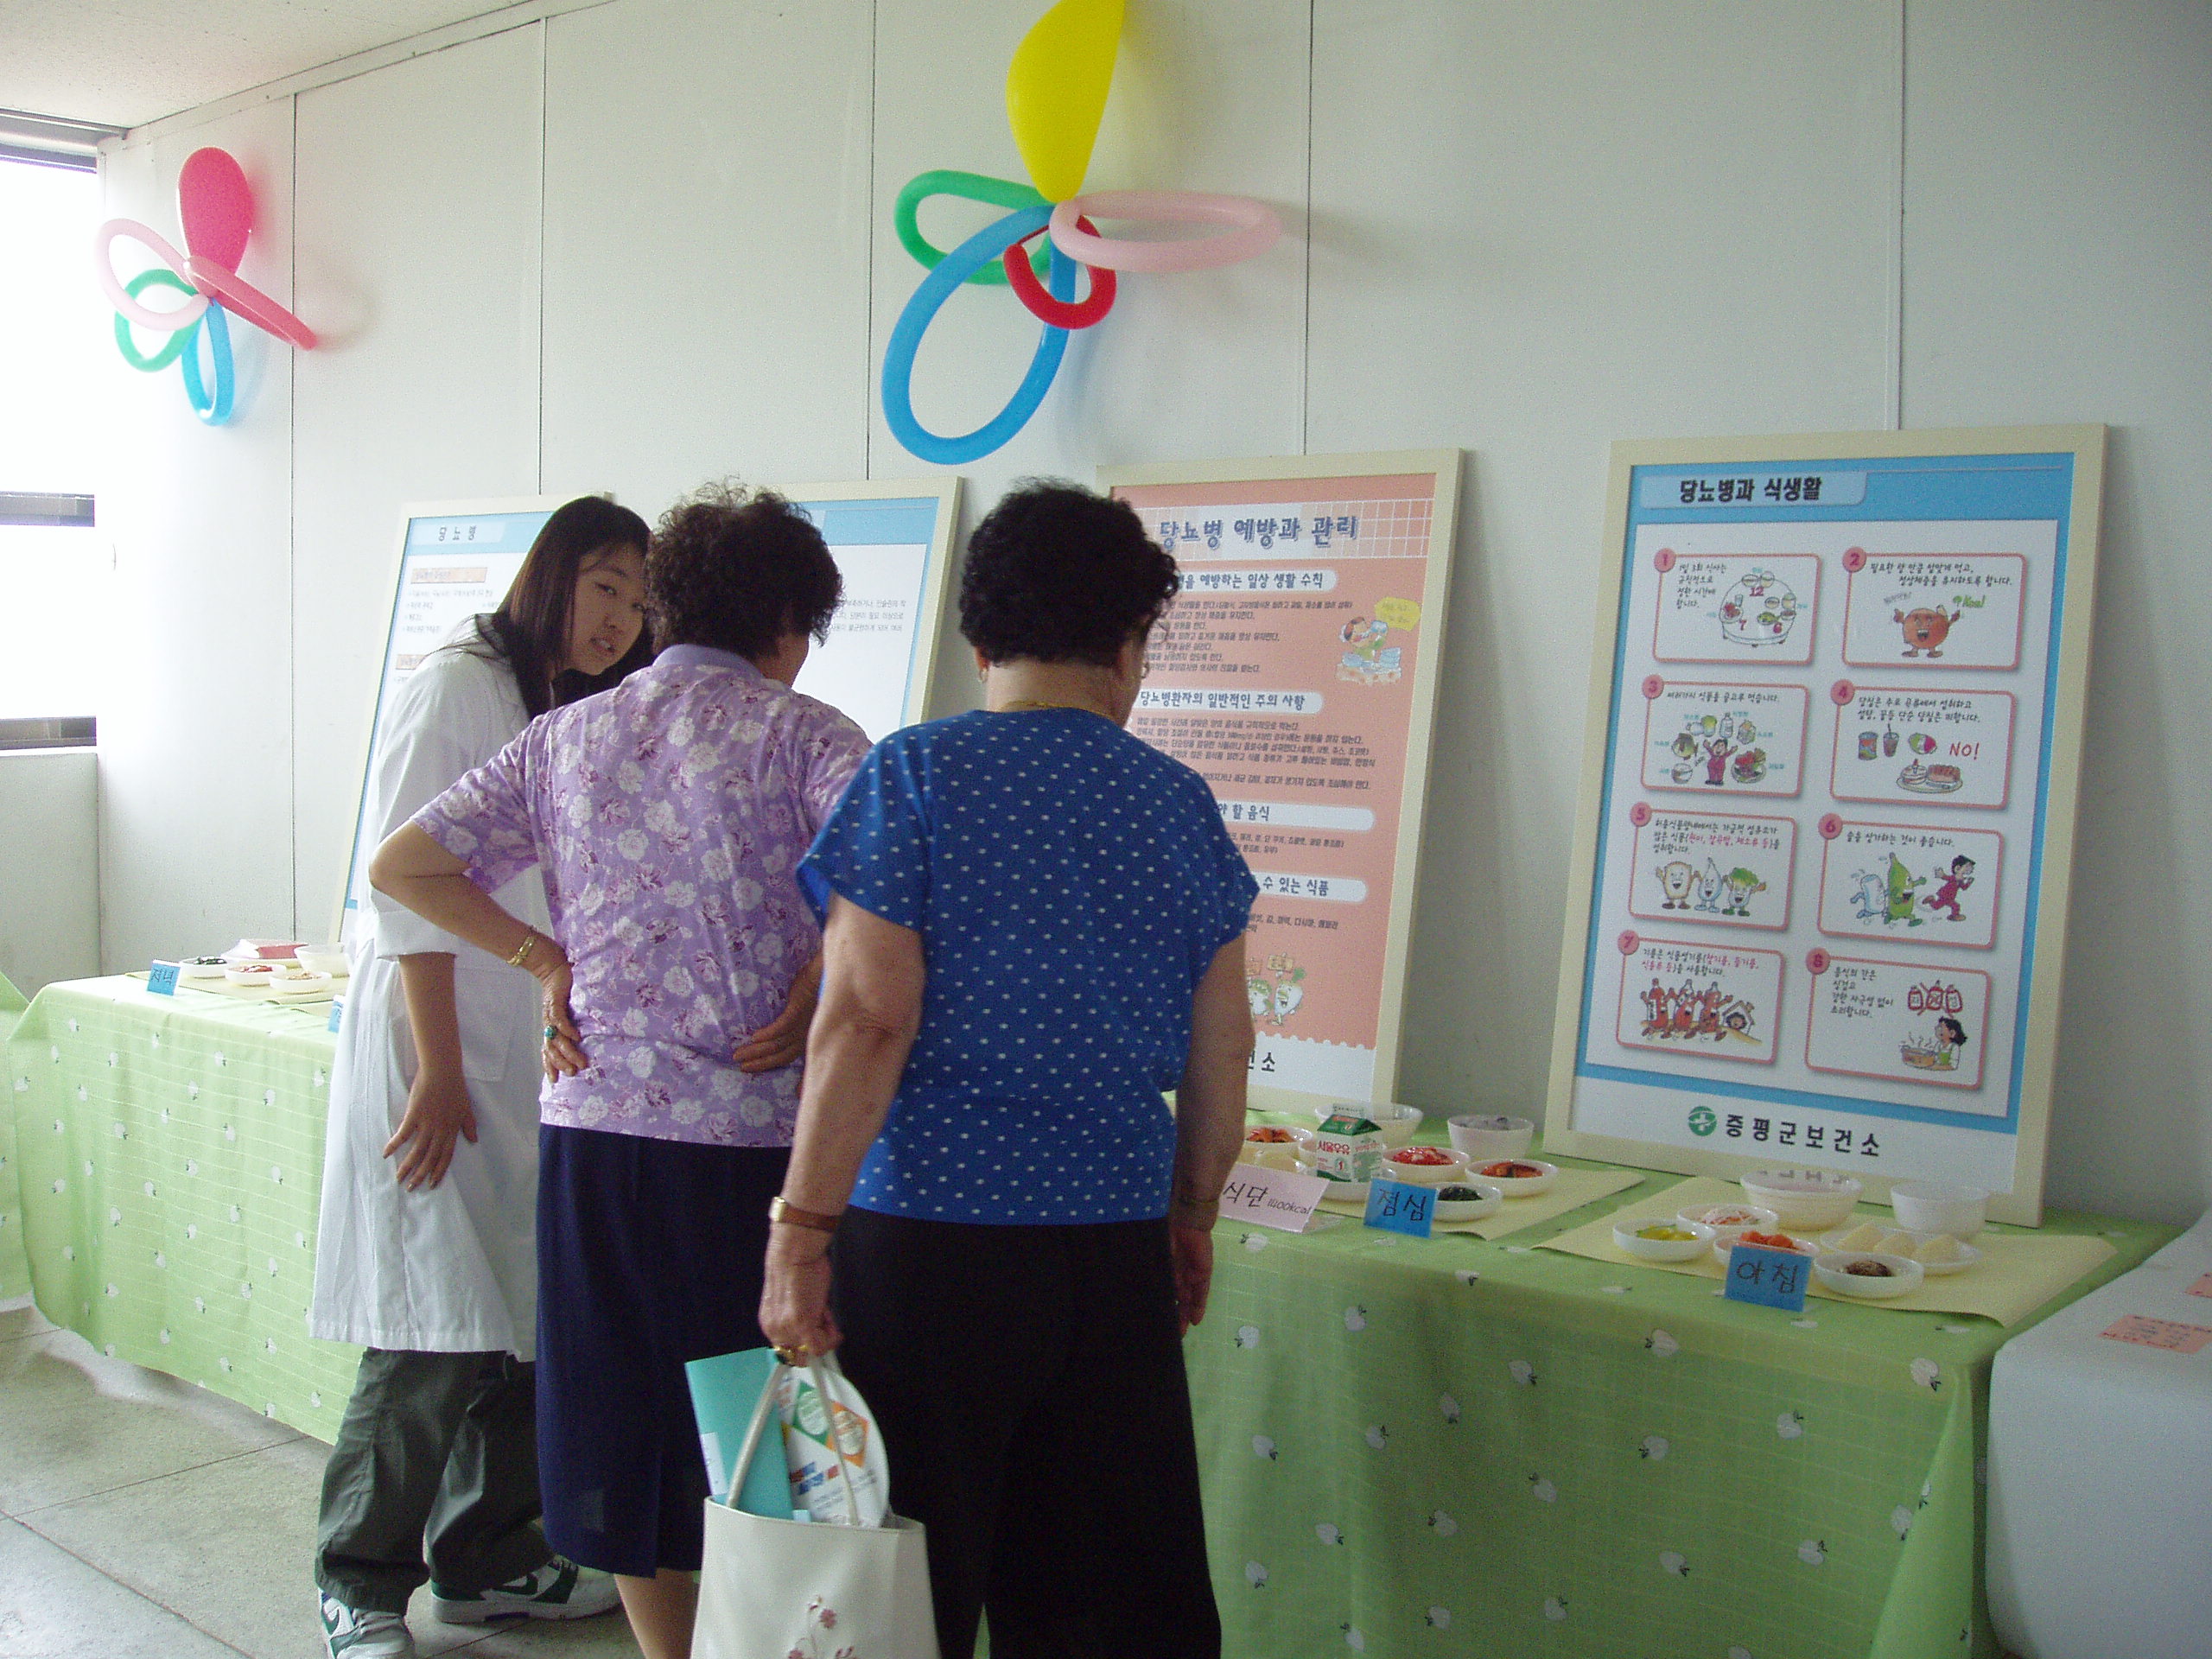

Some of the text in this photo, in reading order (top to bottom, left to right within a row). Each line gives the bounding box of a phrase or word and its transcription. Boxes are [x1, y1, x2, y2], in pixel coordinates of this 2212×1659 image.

[1680, 476, 1821, 505] 당뇨병과 식생활
[439, 525, 477, 542] 당뇨병
[1160, 515, 1359, 550] 당뇨병 예방과 관리
[1662, 553, 1669, 566] 1
[1849, 553, 1860, 566] 2
[1199, 574, 1243, 590] 예방하는
[1247, 573, 1268, 590] 일상
[1274, 573, 1297, 590] 생활
[1300, 573, 1324, 590] 수칙
[1985, 575, 2012, 588] 합니다.
[1749, 586, 1764, 597] 12
[1676, 599, 1700, 610] 합니다.
[1738, 619, 1747, 632] 7
[1140, 691, 1306, 711] 당뇨병환자의 일반적인 주의 사항
[1747, 693, 1780, 704] 먹습니다.
[1945, 711, 1981, 724] 피합니다.
[1949, 741, 1980, 760] NO!
[1232, 804, 1243, 820] 할
[1247, 804, 1270, 822] 음식
[1825, 821, 1836, 833] 6
[1919, 836, 1955, 849] 좋습니다.
[1262, 876, 1329, 897] 수 있는 식품
[1726, 1114, 1879, 1158] 증평군보건소
[1222, 1181, 1268, 1208] 식단
[1376, 1188, 1427, 1222] 점심
[1736, 1260, 1798, 1294] 아침
